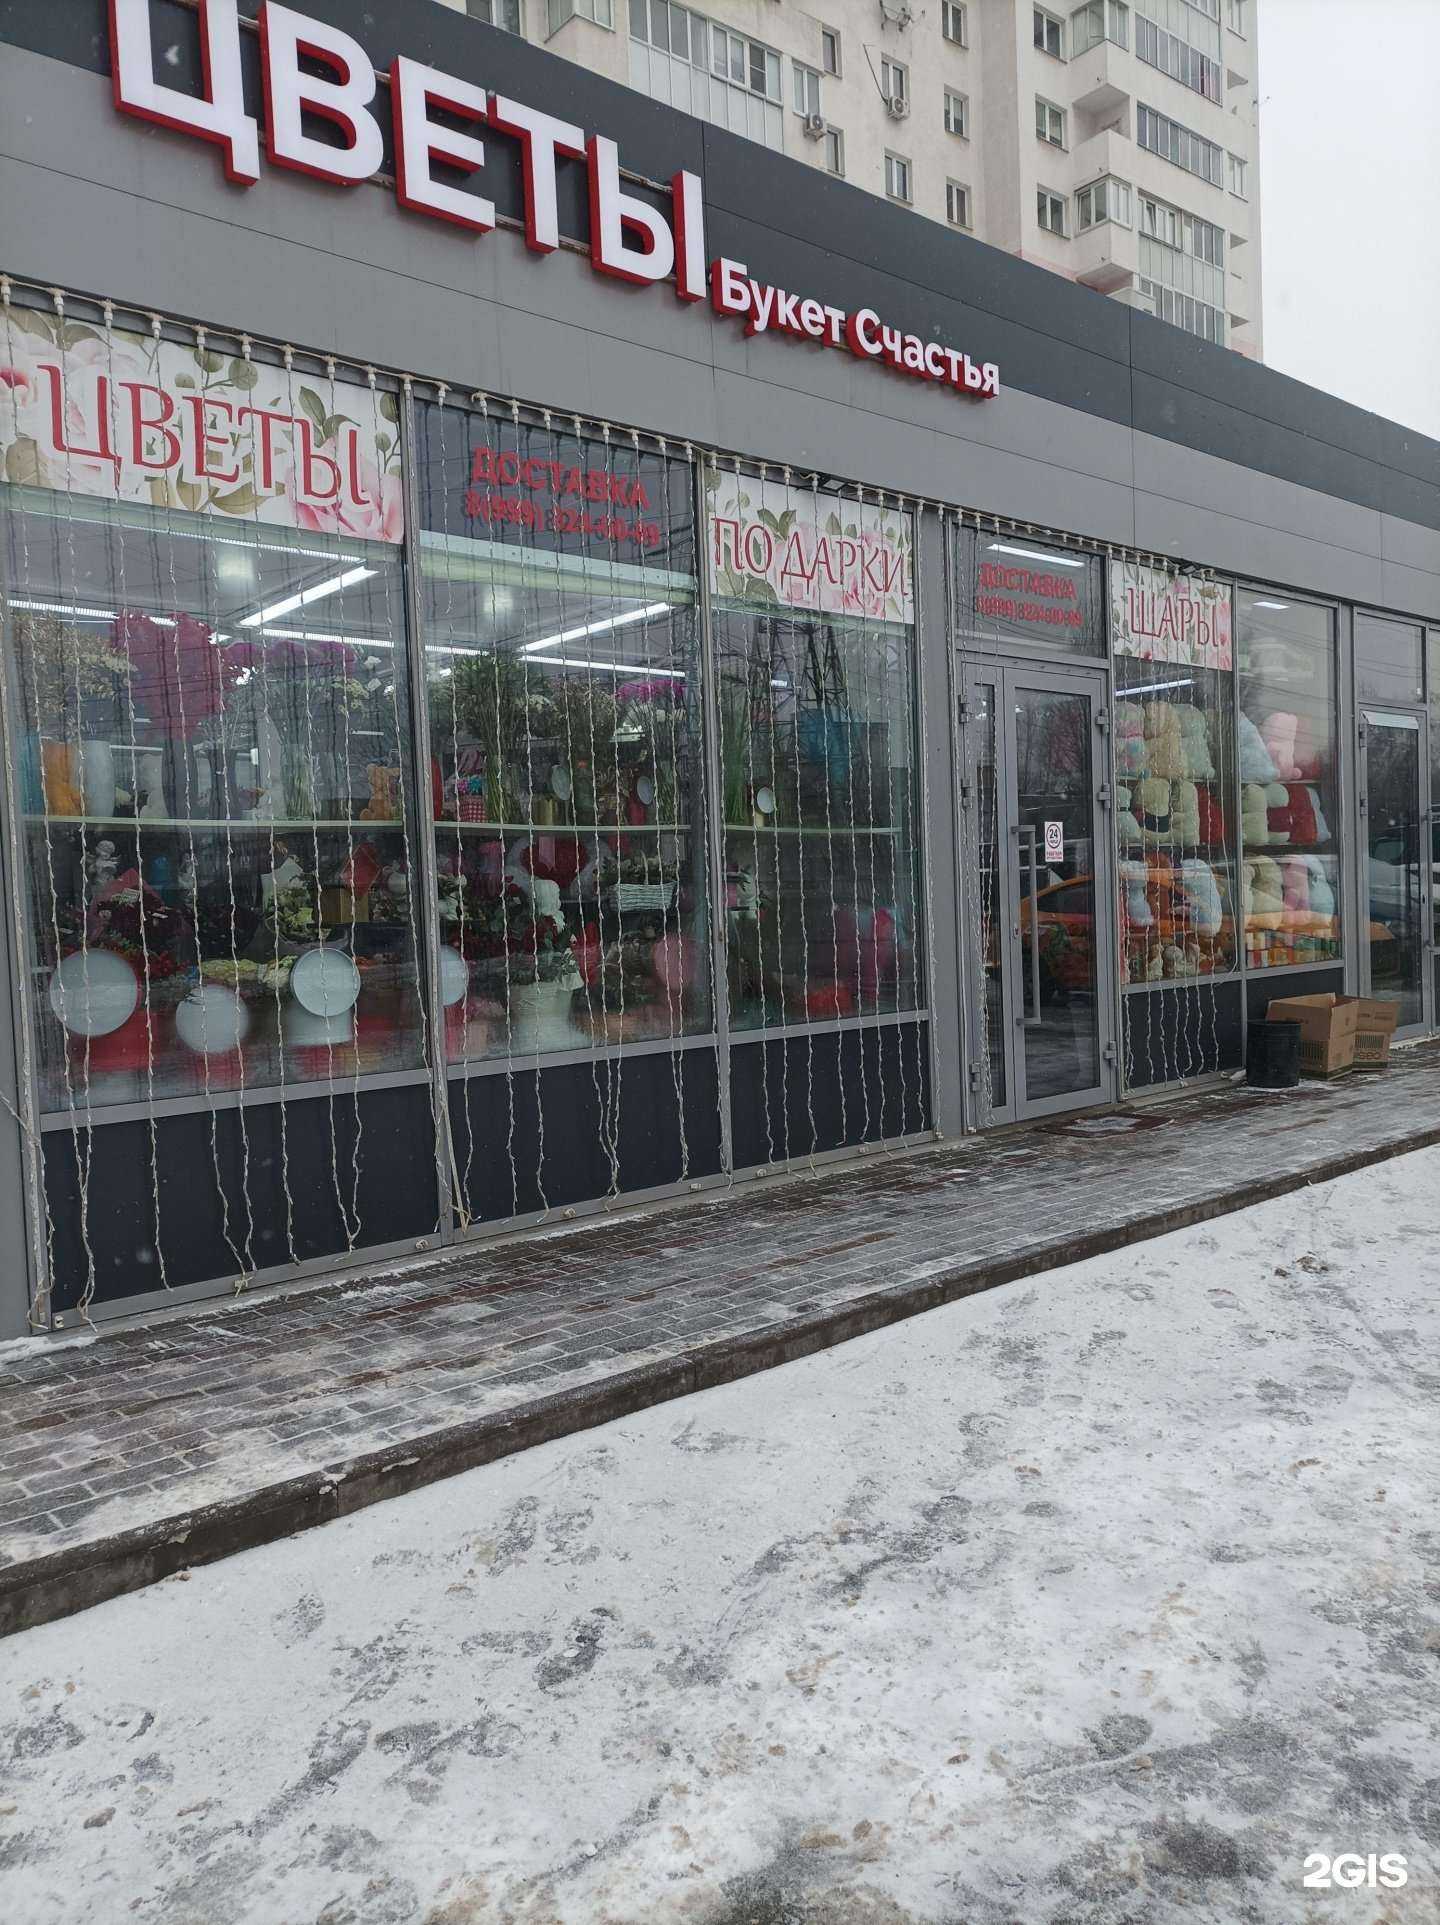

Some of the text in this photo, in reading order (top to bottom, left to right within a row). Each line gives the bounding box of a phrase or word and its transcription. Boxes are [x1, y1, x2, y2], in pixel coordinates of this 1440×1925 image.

[110, 0, 707, 301] ЦВЕТЫ
[714, 257, 1000, 397] Букет Счастья
[37, 364, 370, 506] ЦВЕТЫ
[471, 447, 650, 511] ДОСТАВКА
[711, 517, 909, 597] ПОДАРКИ
[978, 562, 1078, 601] ДОСТАВКА
[1127, 587, 1219, 648] ШАРЫ
[1049, 828, 1058, 839] 24
